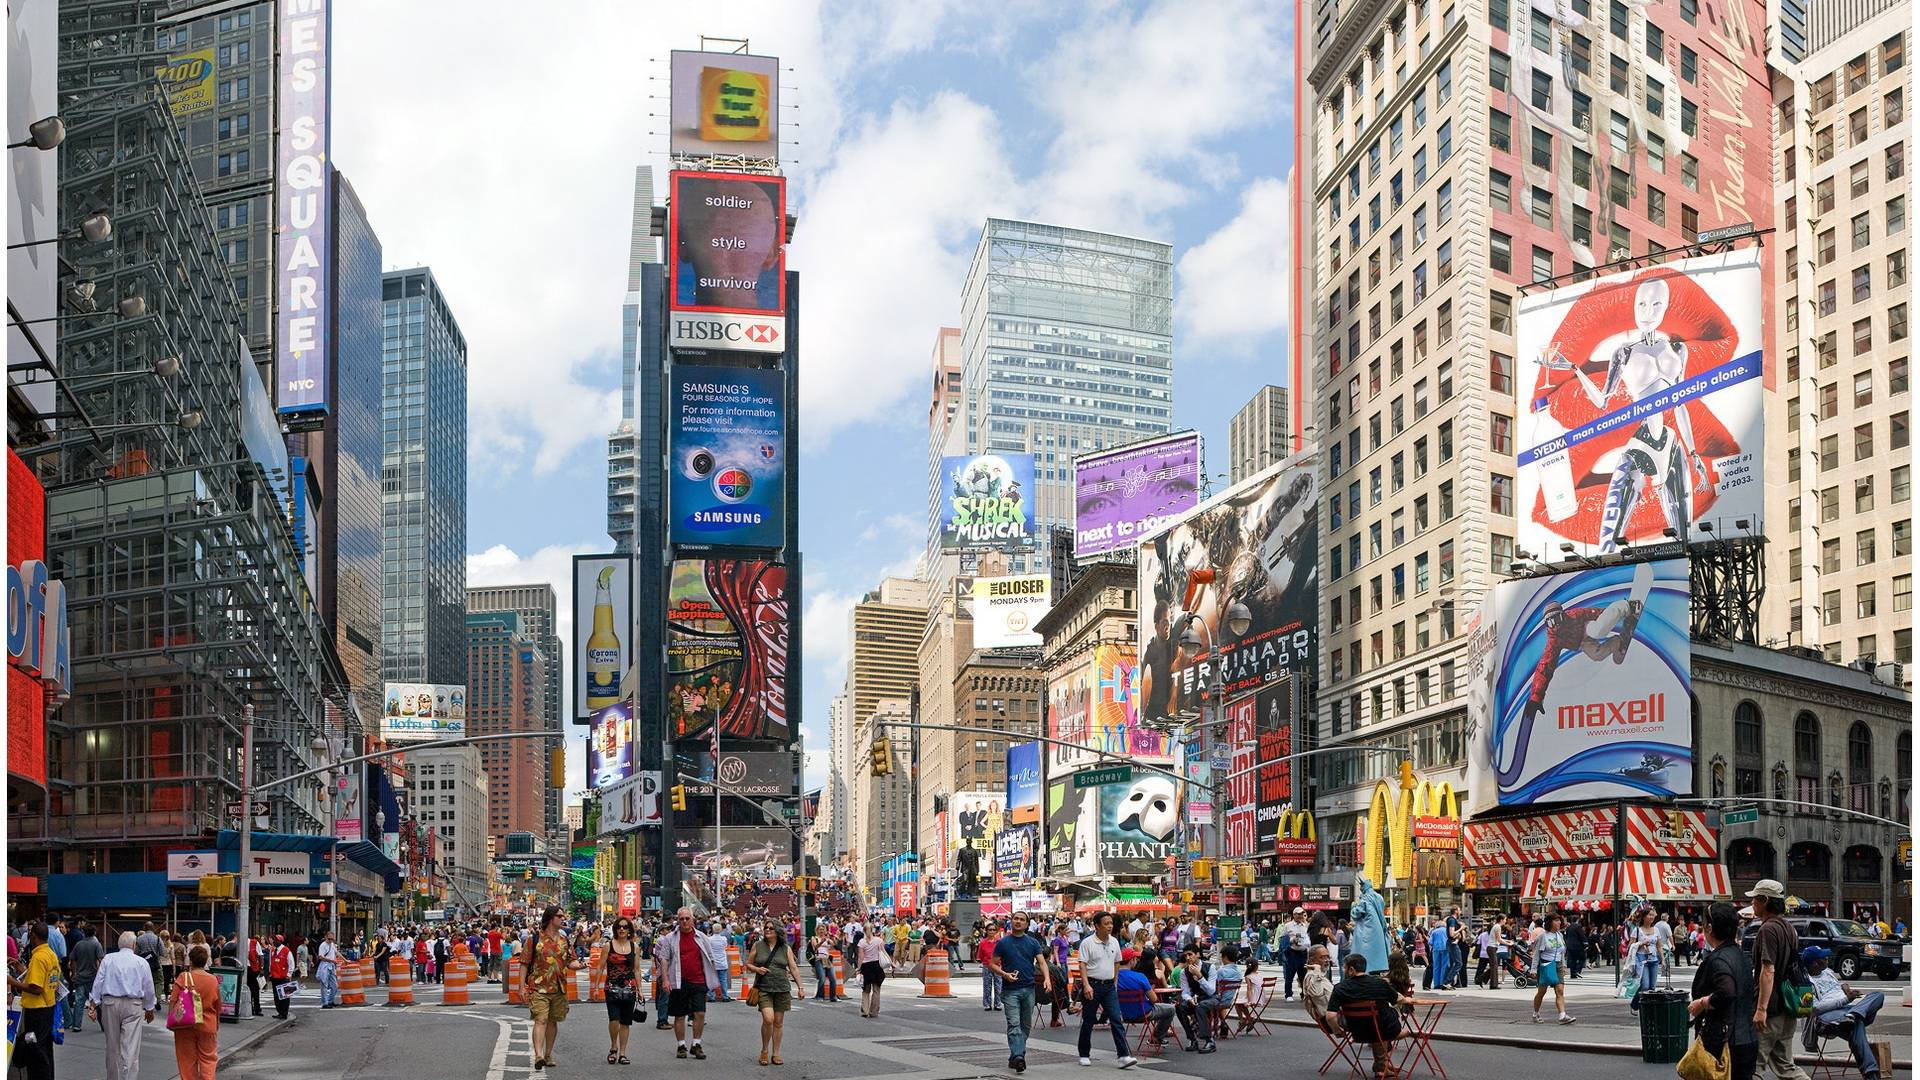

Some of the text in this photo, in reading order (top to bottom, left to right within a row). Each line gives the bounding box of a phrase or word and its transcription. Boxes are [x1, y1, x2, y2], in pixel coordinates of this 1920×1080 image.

[180, 99, 211, 111] Station
[705, 195, 752, 208] soldier
[286, 115, 322, 354] SQUARE
[711, 237, 746, 250] style
[700, 277, 757, 289] survivor
[676, 320, 742, 342] HSBC
[288, 379, 314, 391] NYC
[682, 382, 749, 395] SAMSUNG'S
[704, 395, 739, 403] SEASONS
[1572, 367, 1749, 442] man cannot live on gossip alone.
[682, 405, 776, 417] For more information
[682, 416, 733, 425] please visit
[1533, 434, 1568, 459] SVEDKA
[1541, 455, 1565, 468] VODKA
[1716, 453, 1753, 468] voted #1
[1724, 465, 1750, 478] vodka
[1720, 477, 1754, 491] of 2033.
[952, 497, 1027, 525] SHREK
[1600, 460, 1630, 553] SVEDKA
[694, 512, 761, 524] SAMSUNG
[956, 522, 1027, 542] MUSICAL
[1079, 523, 1113, 544] next
[1116, 521, 1135, 536] to
[990, 580, 1044, 596] THE CLOSER
[681, 601, 711, 610] Open
[990, 596, 1044, 606] MONDAYS 9pm
[667, 609, 726, 621] Happiness
[1241, 636, 1256, 646] SAM
[1256, 620, 1303, 641] WORTHINGTON
[589, 649, 618, 659] Corona
[706, 647, 732, 656] Janelle
[1171, 626, 1317, 687] TERINATO
[1184, 647, 1308, 695] SAVATION
[1238, 676, 1262, 689] BACK
[1264, 667, 1290, 681] 05.21
[1558, 693, 1664, 730] maxell
[1586, 725, 1665, 737] www.maxell.com
[1260, 740, 1290, 763] WAY'S
[1261, 761, 1290, 780] SURE
[1081, 771, 1122, 785] Broadway
[743, 785, 780, 793] LACROSSE
[1260, 775, 1290, 803] THING
[1416, 822, 1458, 831] McDonald's
[1477, 841, 1501, 850] FRIDAY'S
[1522, 837, 1548, 847] FRIDAY'S
[1098, 841, 1176, 859] PHANT
[267, 867, 305, 876] TISHMAN
[623, 883, 637, 907] tkts
[900, 884, 913, 908] tkts
